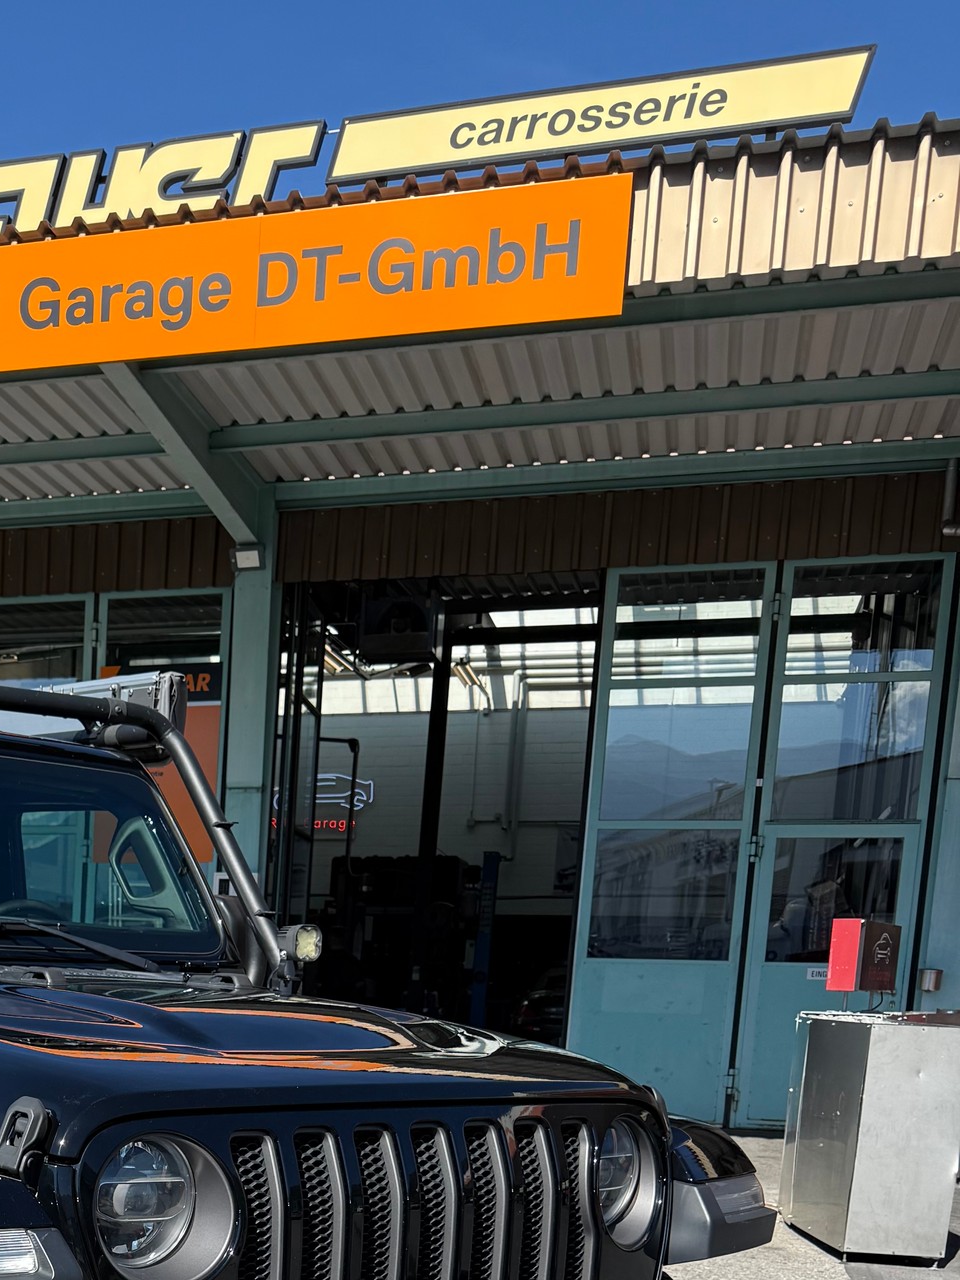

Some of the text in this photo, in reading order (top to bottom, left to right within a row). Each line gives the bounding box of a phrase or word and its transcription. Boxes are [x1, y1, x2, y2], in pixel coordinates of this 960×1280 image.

[449, 83, 728, 150] carrosserie
[19, 272, 232, 331] Garage
[257, 219, 581, 307] DT-GmbH
